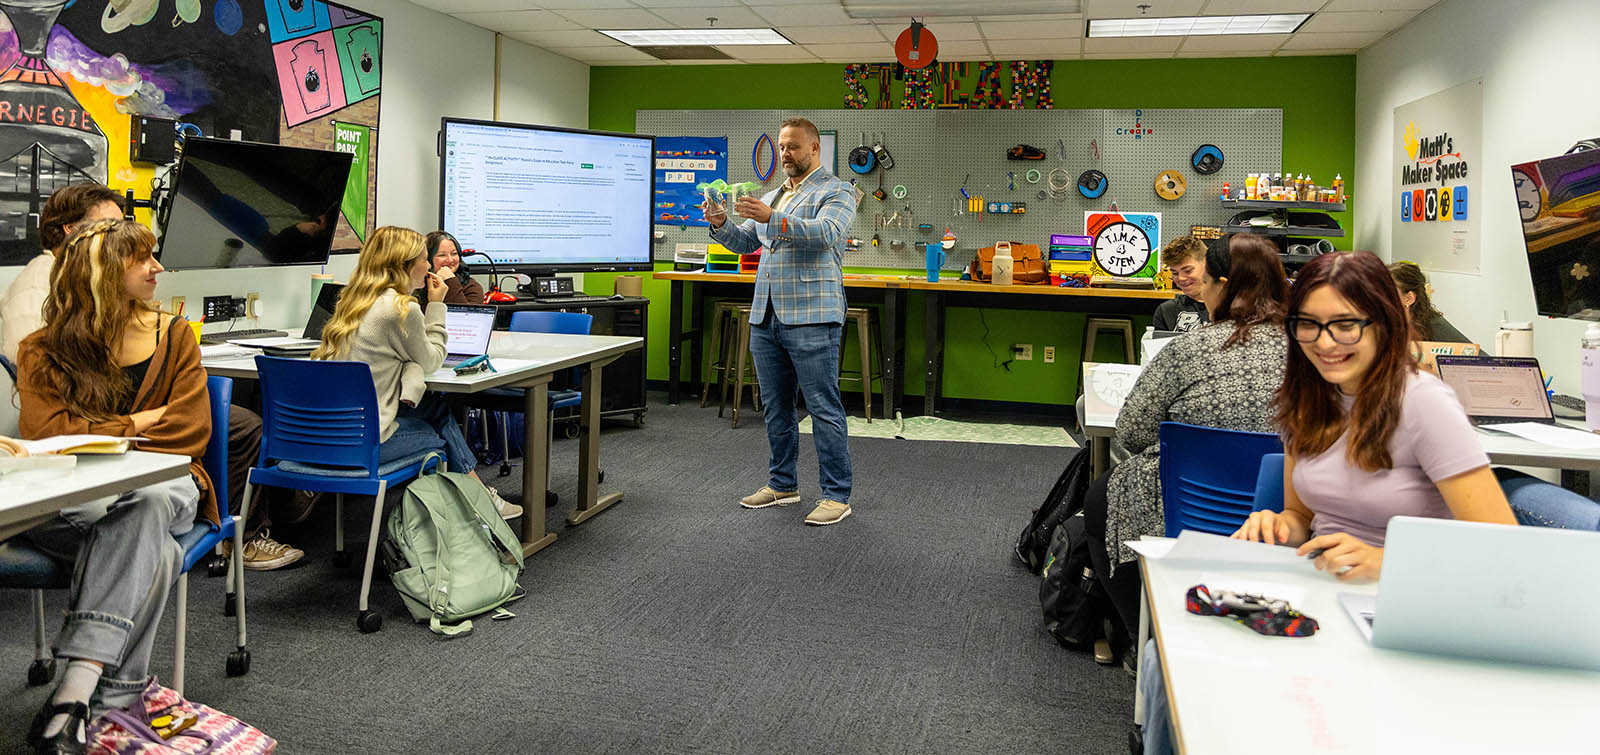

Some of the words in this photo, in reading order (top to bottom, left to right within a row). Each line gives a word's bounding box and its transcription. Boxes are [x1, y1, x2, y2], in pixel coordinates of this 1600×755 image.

[843, 60, 1053, 109] STREAM
[337, 128, 362, 143] POINT
[1116, 127, 1153, 135] Create
[336, 142, 358, 156] PARK
[1419, 132, 1453, 159] Matt's
[656, 160, 714, 168] elcome
[1402, 161, 1433, 186] Maker
[1435, 159, 1468, 186] Space
[1116, 244, 1126, 254] 4
[1108, 256, 1136, 267] STEM
